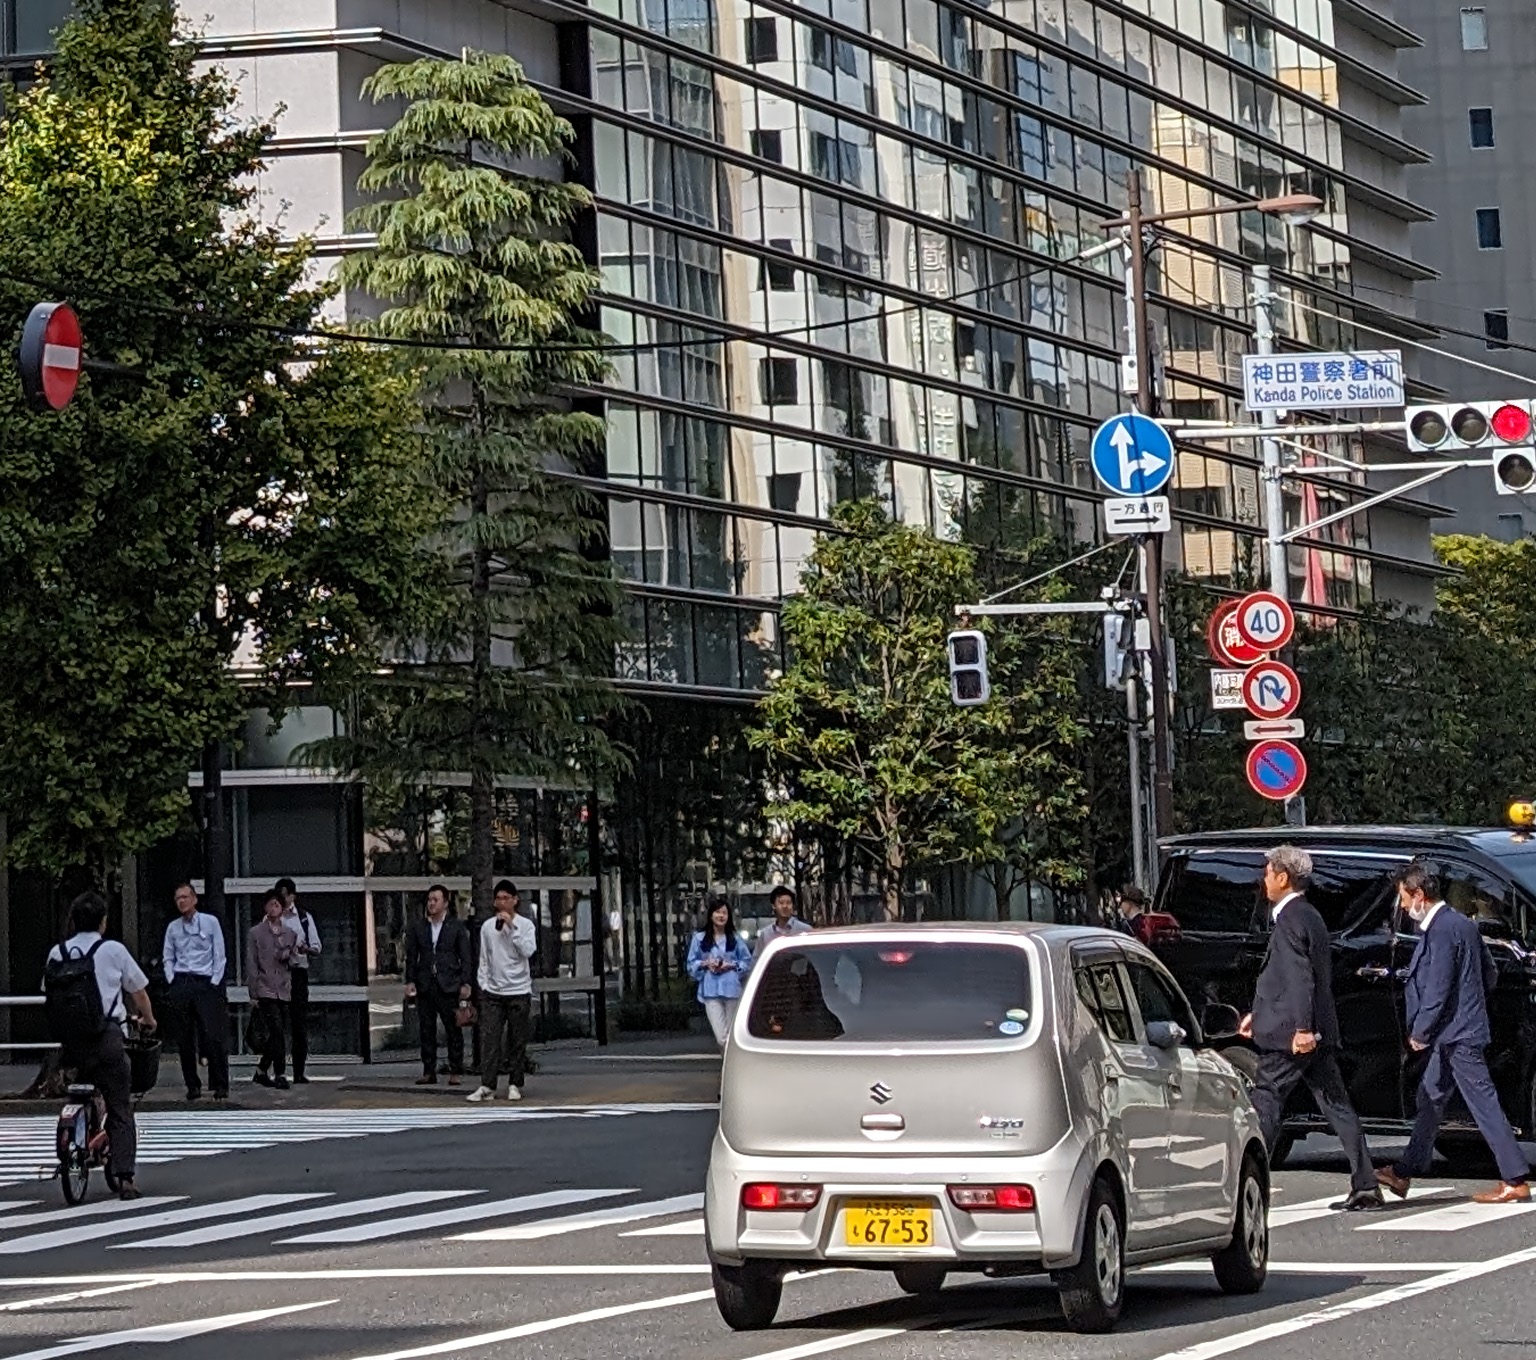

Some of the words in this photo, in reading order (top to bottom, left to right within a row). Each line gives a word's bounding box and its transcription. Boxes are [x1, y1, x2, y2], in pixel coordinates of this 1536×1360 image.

[1251, 357, 1394, 385] 神田警察署前
[1254, 387, 1296, 403] Kanda
[1301, 385, 1343, 401] Police
[1347, 384, 1395, 400] Station
[1250, 609, 1280, 634] 40
